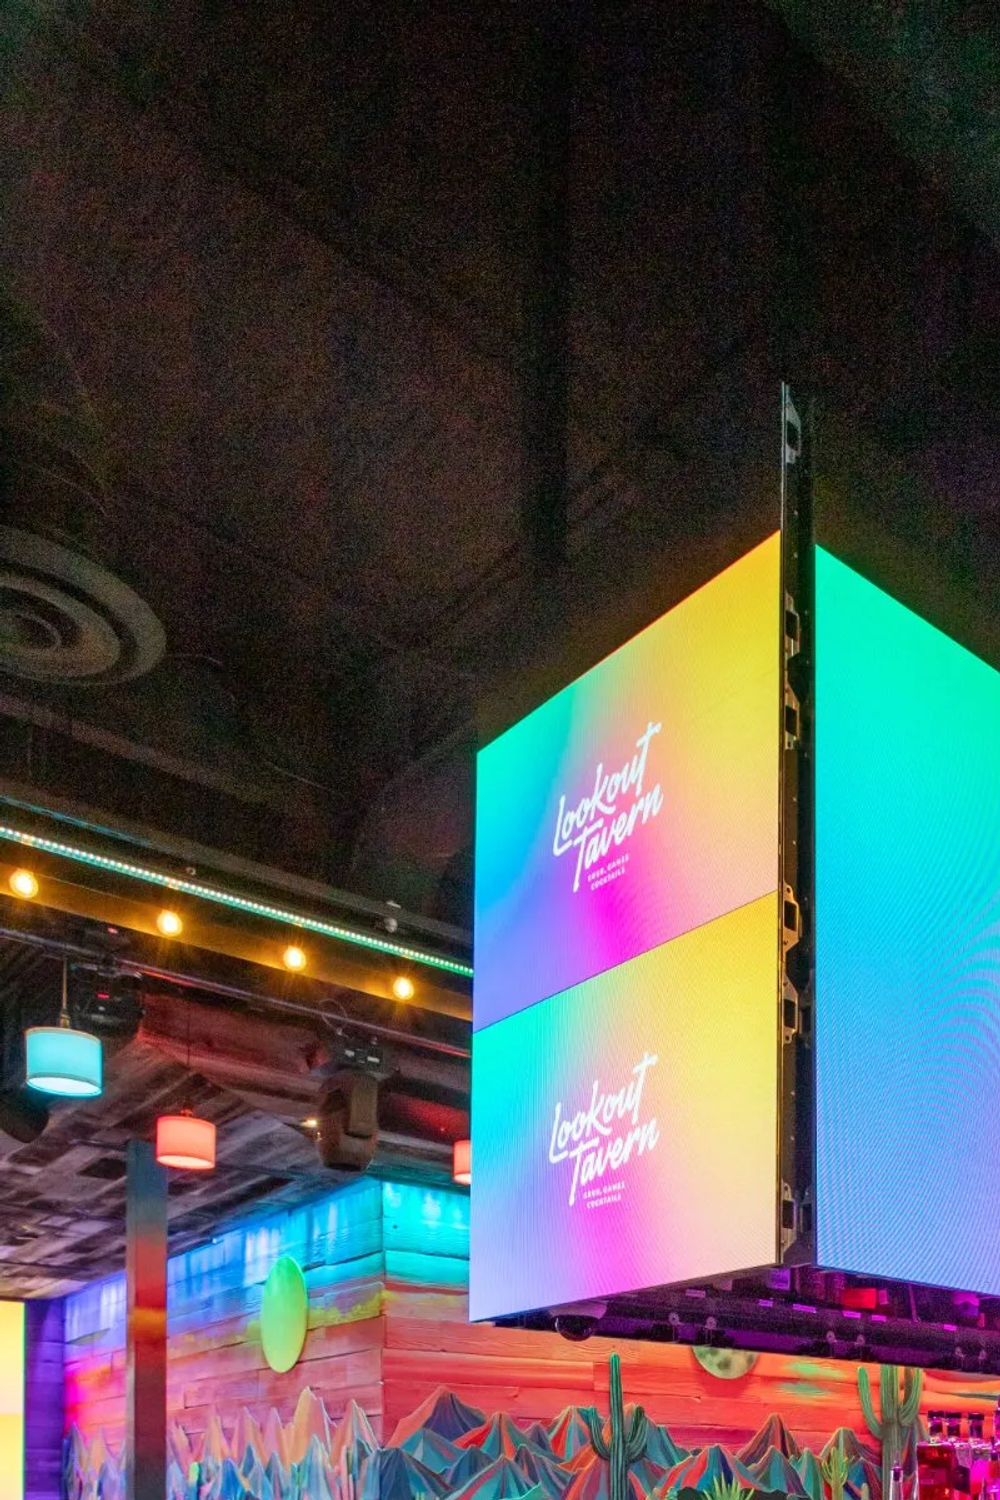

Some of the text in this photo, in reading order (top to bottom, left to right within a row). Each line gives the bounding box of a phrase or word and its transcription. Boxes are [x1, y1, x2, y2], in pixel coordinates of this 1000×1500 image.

[553, 721, 661, 856] Lookout
[572, 783, 664, 893] Tavern
[549, 1051, 658, 1164] Lookout
[569, 1118, 660, 1207] Tavern
